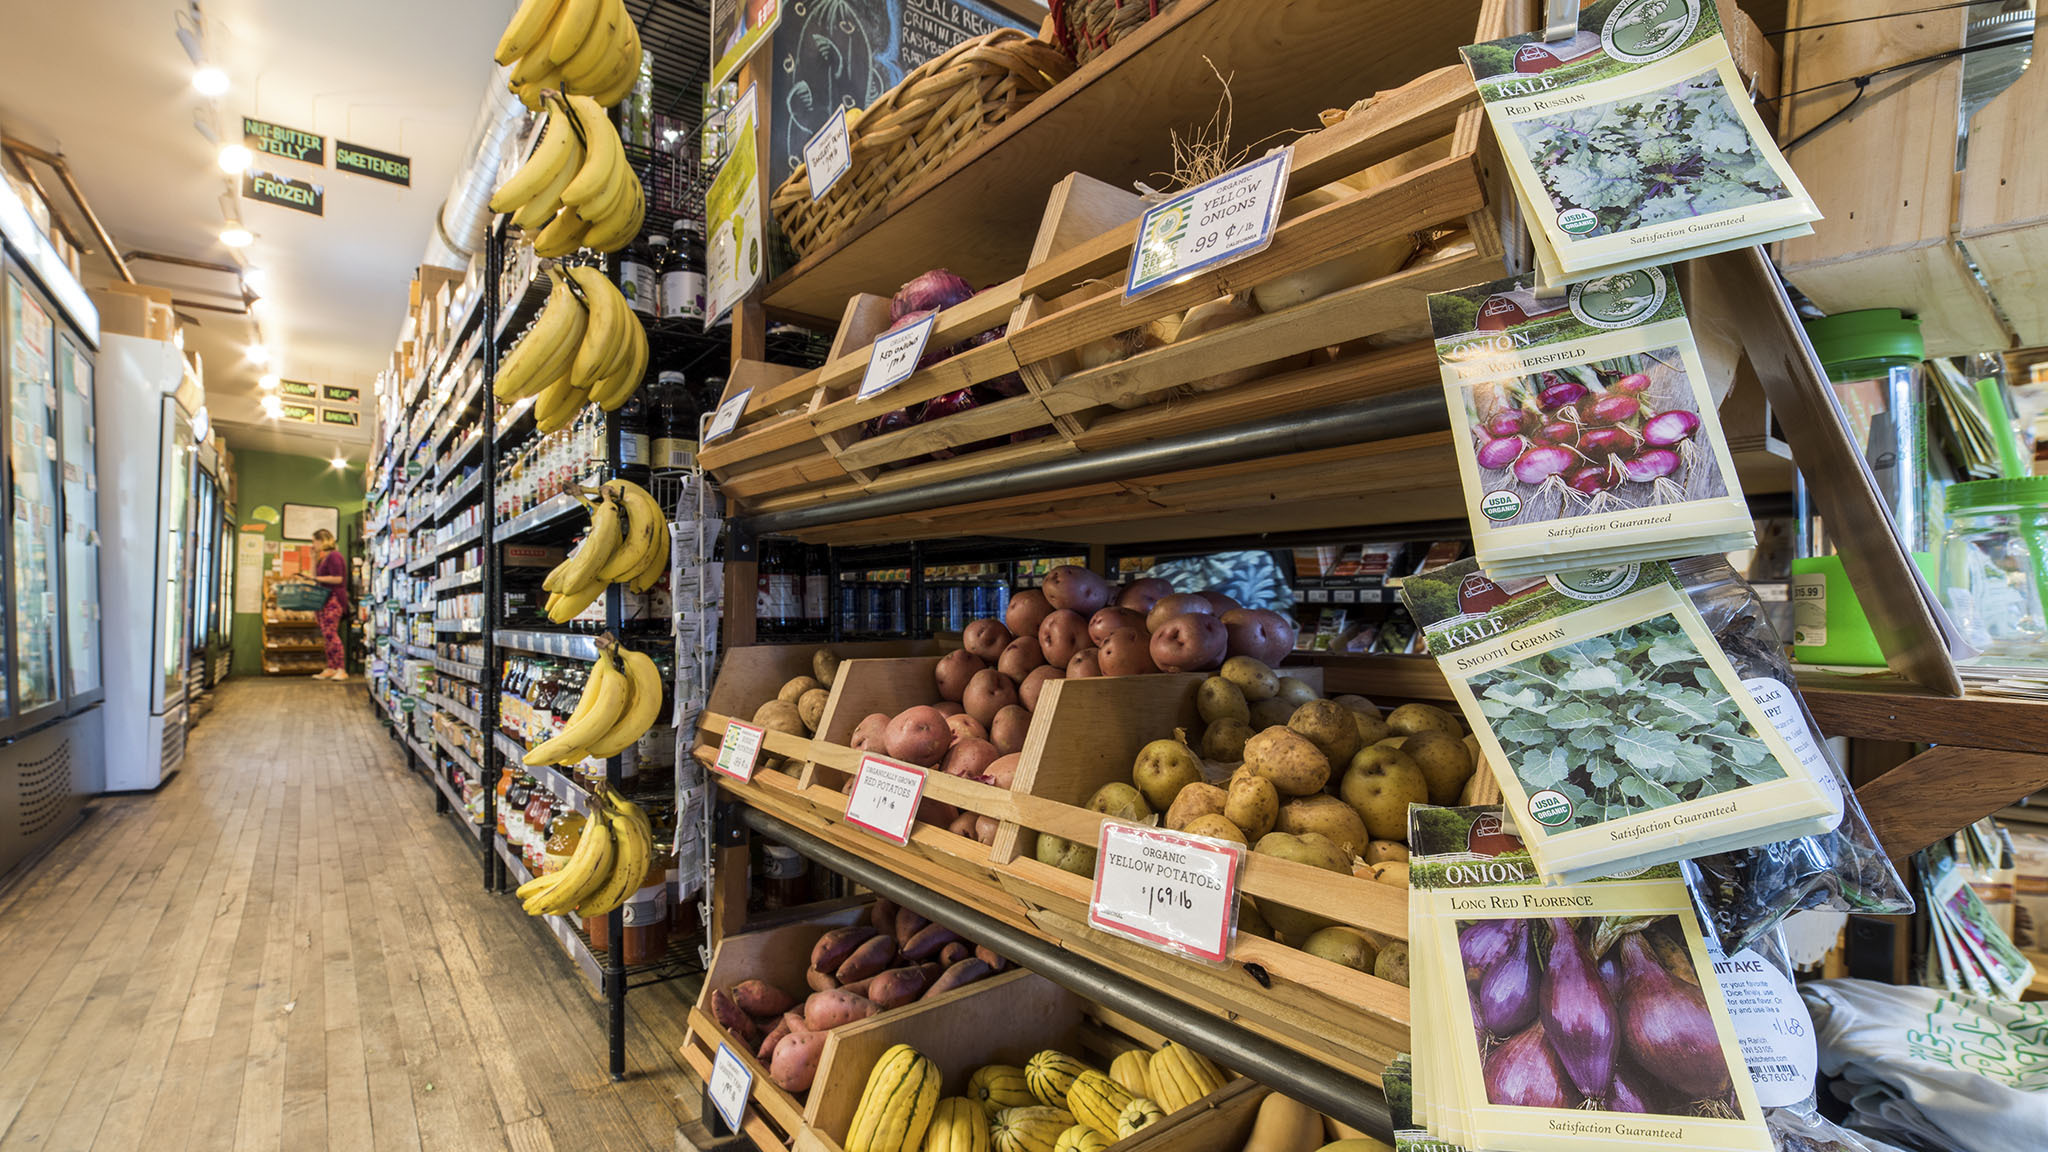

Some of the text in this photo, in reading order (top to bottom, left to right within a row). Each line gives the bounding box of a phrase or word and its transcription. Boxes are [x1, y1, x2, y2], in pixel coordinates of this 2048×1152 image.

[1656, 39, 1683, 58] GARDEN
[1497, 76, 1559, 98] KALE
[245, 119, 321, 151] NUT-BUTTER
[258, 137, 309, 160] JELLY
[336, 149, 409, 180] SWEETENERS
[254, 177, 315, 206] FROZEN
[1216, 175, 1253, 194] ORGANIC
[1203, 180, 1262, 212] YELLOW
[1200, 197, 1256, 227] ONIONS
[1563, 212, 1588, 223] USDA
[1564, 219, 1595, 231] ORGANIC
[1630, 214, 1746, 245] Satisfaction Guaranteed
[1453, 331, 1533, 359] ONION
[1487, 504, 1518, 515] ORGANIC
[1488, 496, 1513, 506] USDA
[1547, 513, 1672, 538] Satisfaction Guaranteed
[1605, 583, 1629, 599] GARDEN
[1442, 615, 1509, 649] KALE
[864, 776, 911, 798] RED POTATOES
[1535, 797, 1560, 809] USDA
[1537, 805, 1568, 820] ORGANIC
[1610, 802, 1738, 841] Satisfaction Guaranteed
[1142, 847, 1186, 865] ORGANIC
[1109, 853, 1222, 891] YELLOW POTATOES
[1445, 862, 1526, 884] ONION
[1730, 981, 1746, 989] your
[1548, 1118, 1683, 1139] Satisfaction Guaranteed
